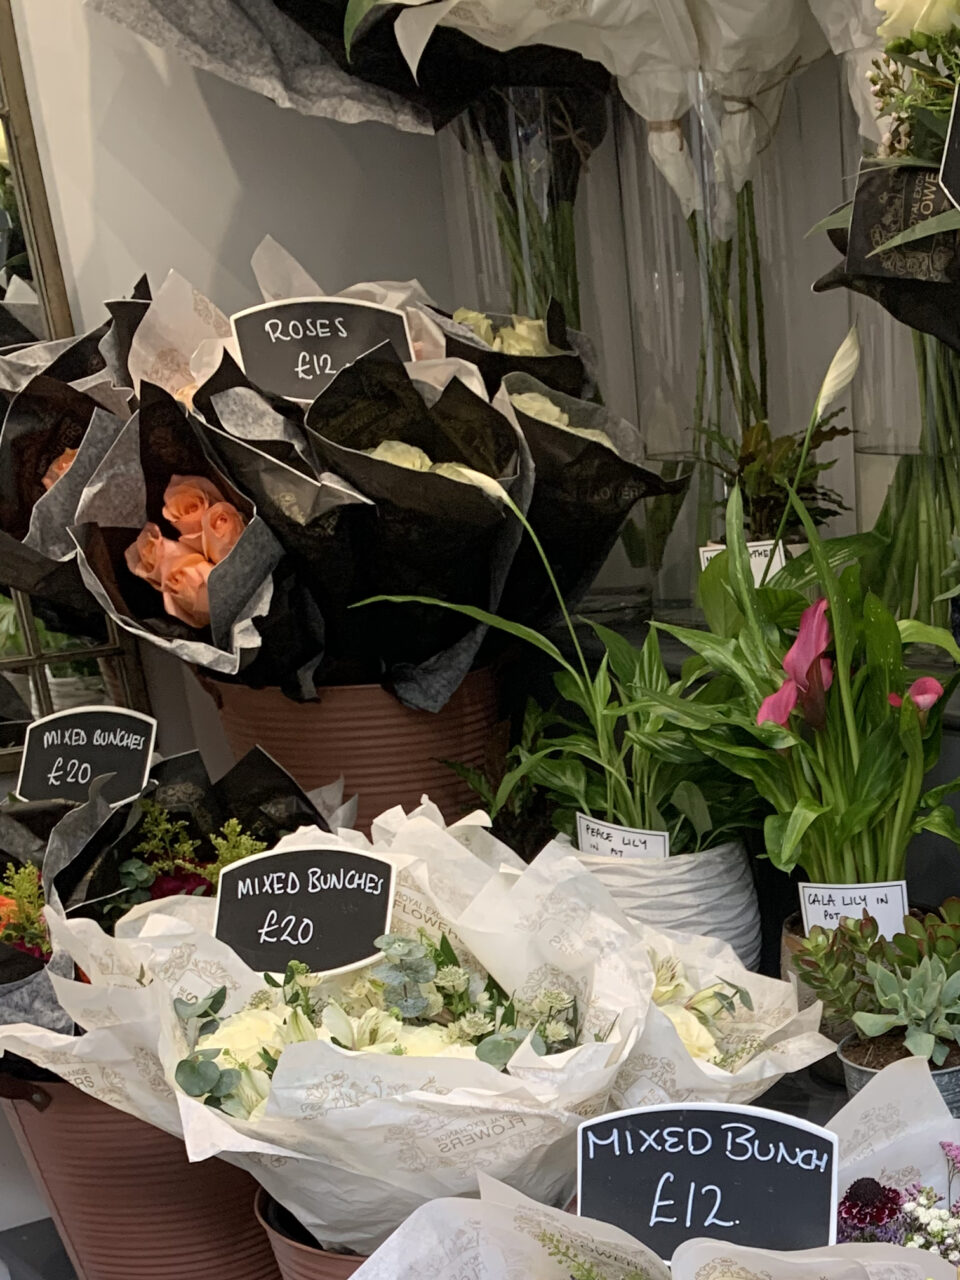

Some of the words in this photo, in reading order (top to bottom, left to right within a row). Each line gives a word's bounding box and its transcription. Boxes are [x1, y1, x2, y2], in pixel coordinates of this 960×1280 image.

[264, 317, 348, 343] ROSES
[294, 351, 337, 380] £12
[43, 728, 87, 748] MIXED
[93, 728, 146, 750] BUNCHES
[47, 757, 91, 786] £20
[622, 836, 647, 850] LILY
[237, 871, 301, 899] MIXED
[307, 867, 384, 896] BUNCHES
[808, 893, 836, 907] CALA
[842, 895, 868, 907] LILY
[876, 893, 889, 905] IN
[258, 909, 314, 945] £20
[824, 910, 840, 920] POT
[587, 1126, 713, 1160] MIXED
[721, 1122, 828, 1172] BUNCH
